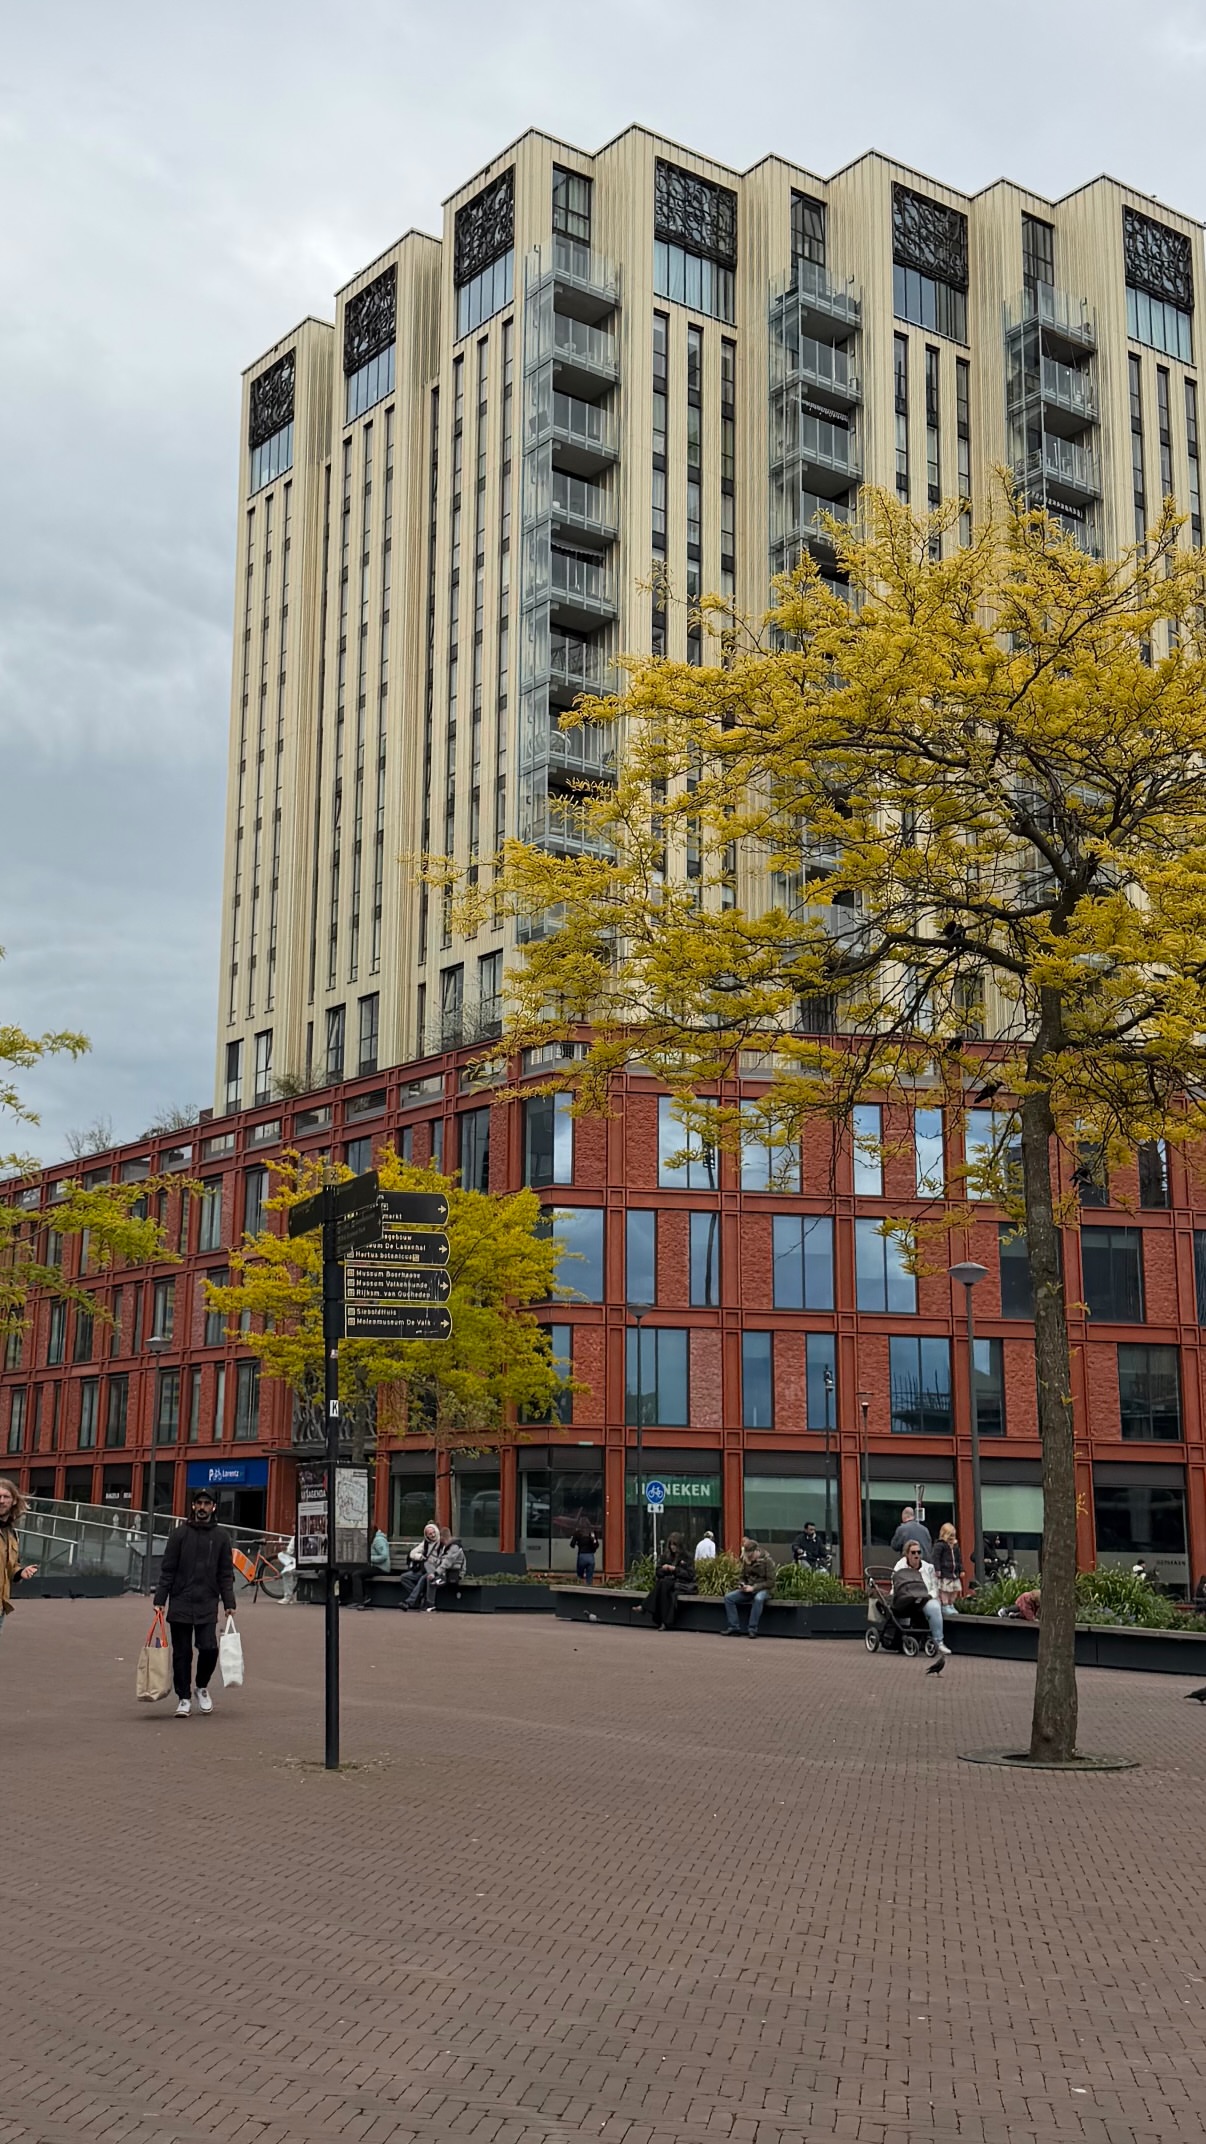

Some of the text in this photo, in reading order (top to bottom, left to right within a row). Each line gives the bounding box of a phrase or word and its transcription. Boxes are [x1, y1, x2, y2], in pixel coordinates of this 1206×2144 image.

[356, 1269, 384, 1277] Museum
[356, 1279, 384, 1287] Museum
[406, 1318, 415, 1326] De
